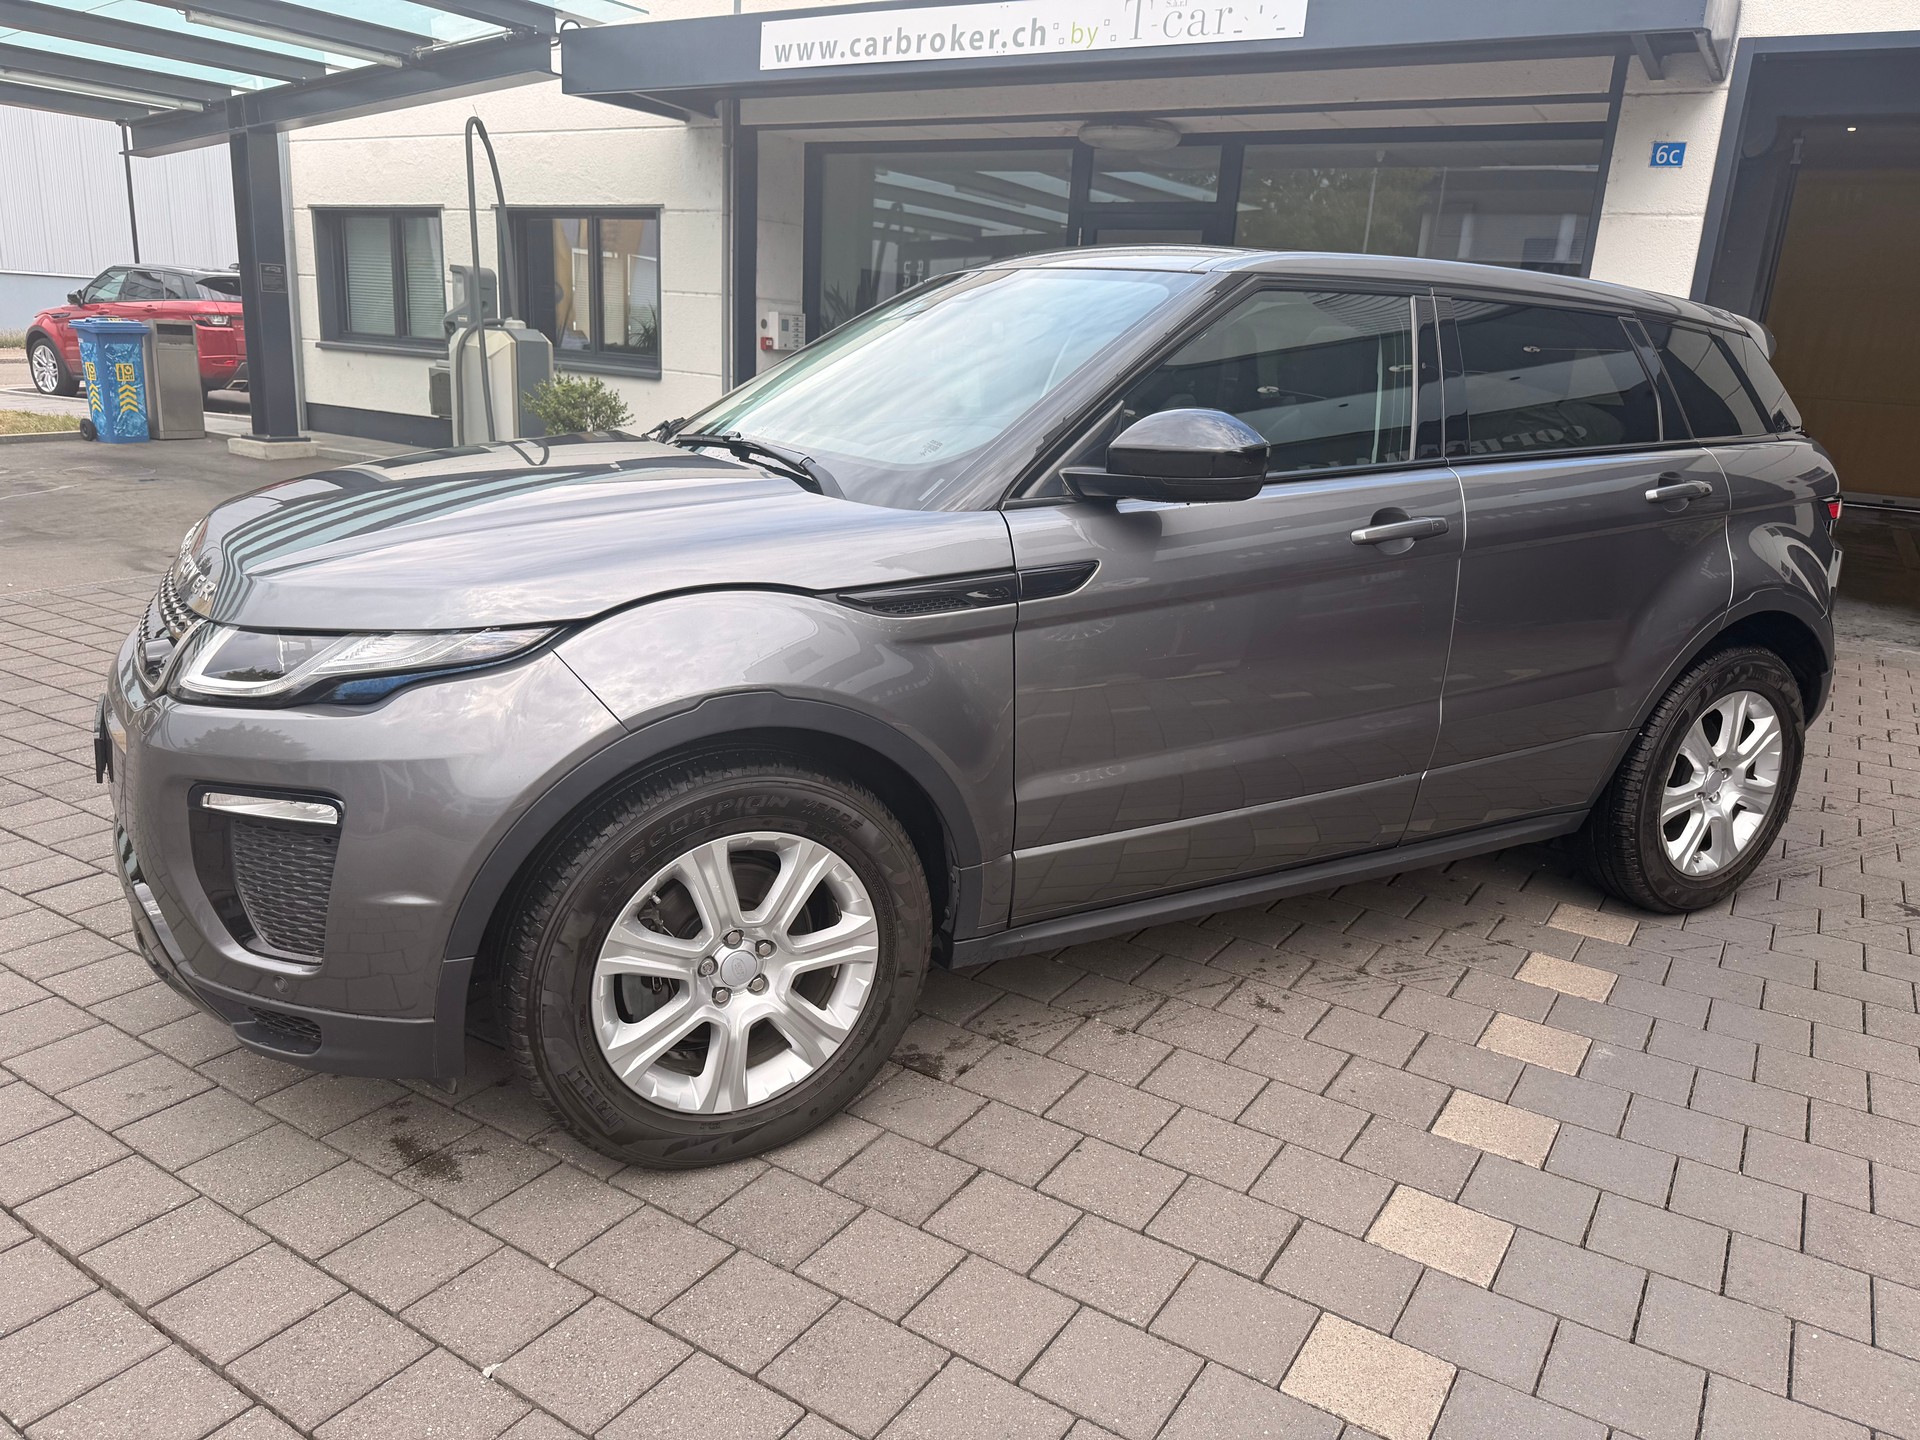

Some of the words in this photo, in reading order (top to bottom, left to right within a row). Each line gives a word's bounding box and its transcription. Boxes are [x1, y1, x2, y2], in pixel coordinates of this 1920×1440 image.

[774, 17, 1047, 63] www.carbroker.ch
[1070, 21, 1099, 49] by
[1656, 145, 1680, 164] 6c
